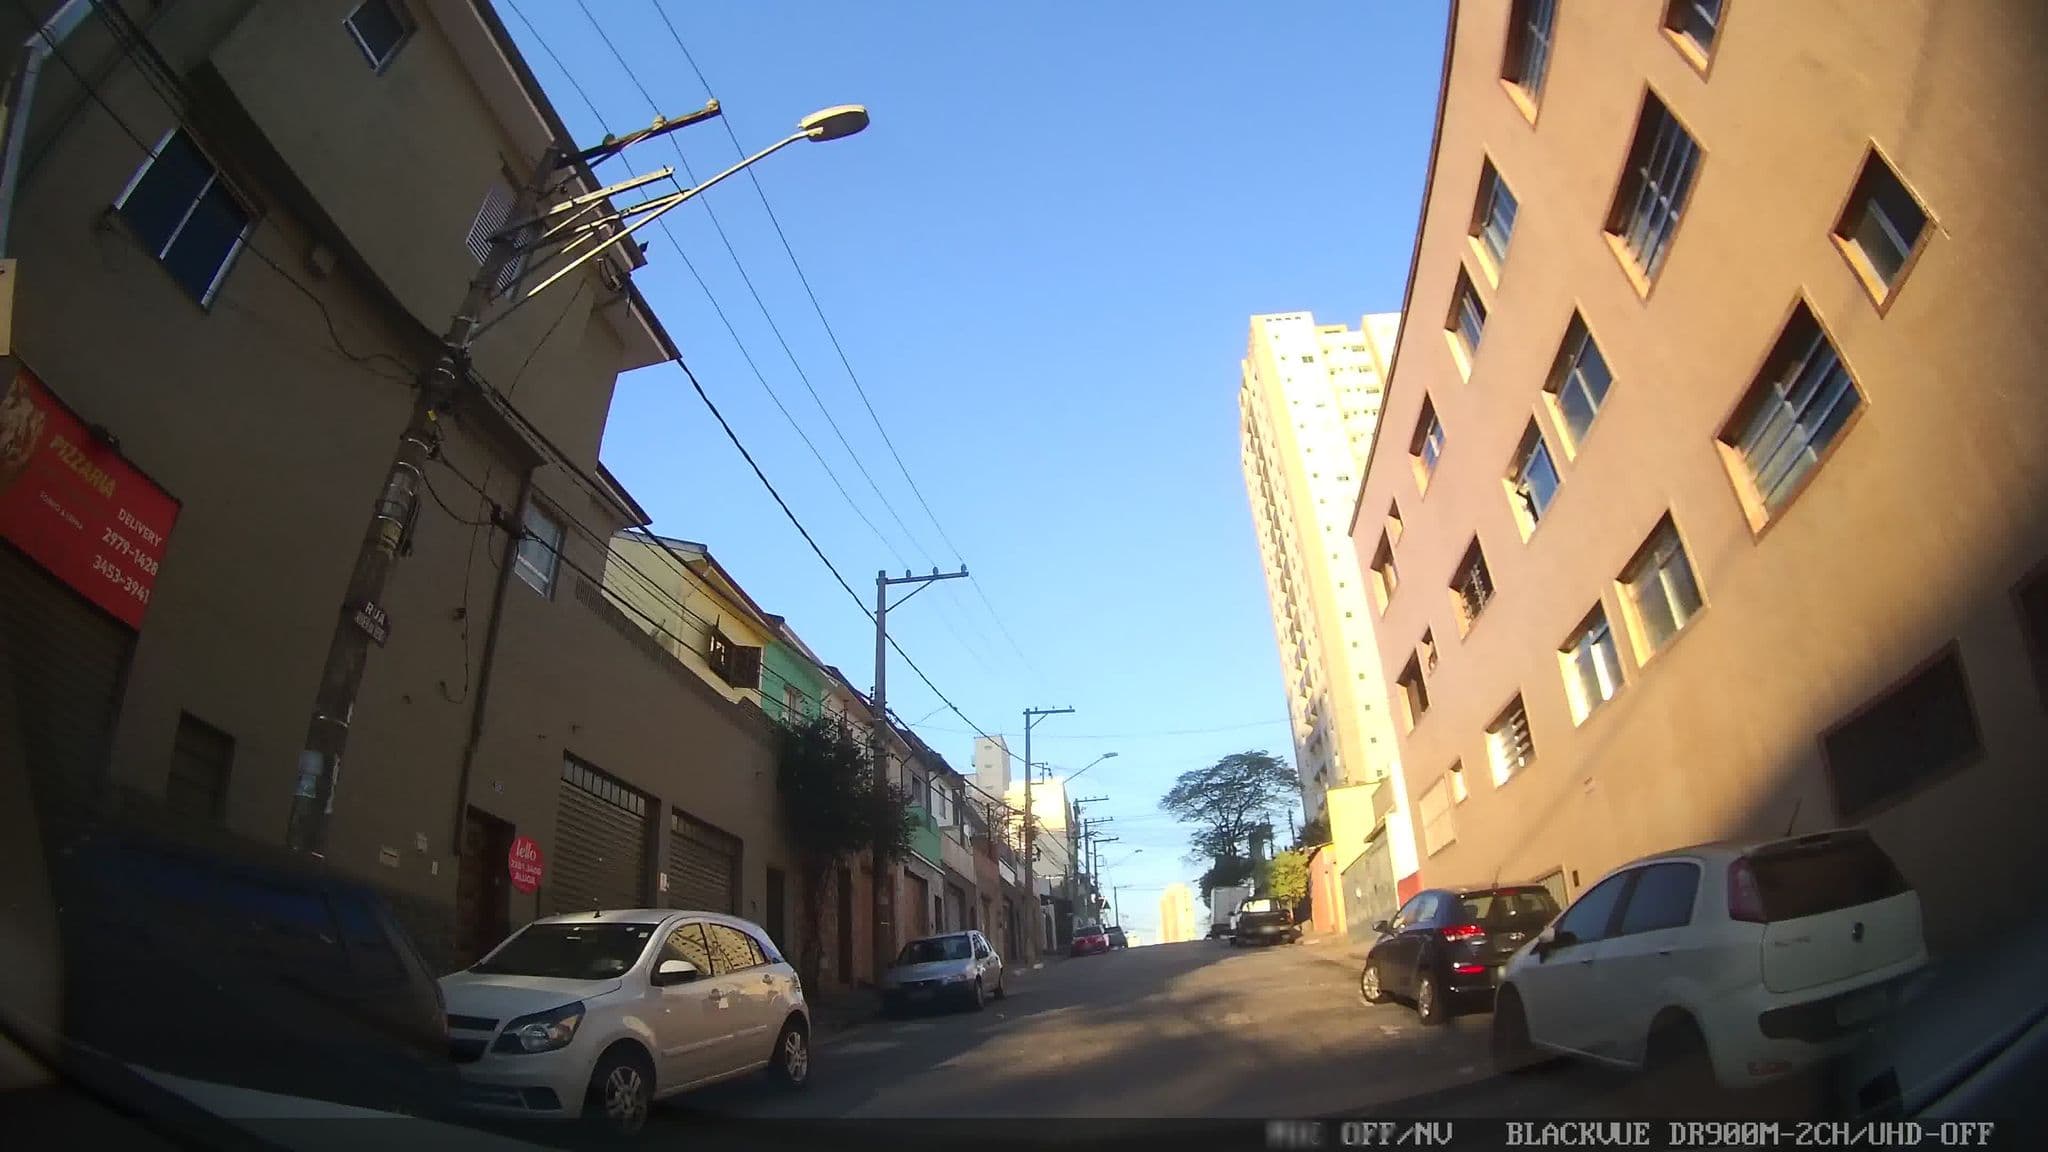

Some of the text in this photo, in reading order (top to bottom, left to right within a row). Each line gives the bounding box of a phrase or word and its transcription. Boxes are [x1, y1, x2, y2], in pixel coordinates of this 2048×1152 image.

[50, 436, 117, 499] PIZZARIA
[102, 527, 159, 576] 2979-1428
[118, 507, 163, 547] DELIVERY
[93, 555, 151, 604] 3453-3941
[365, 601, 385, 625] RUA
